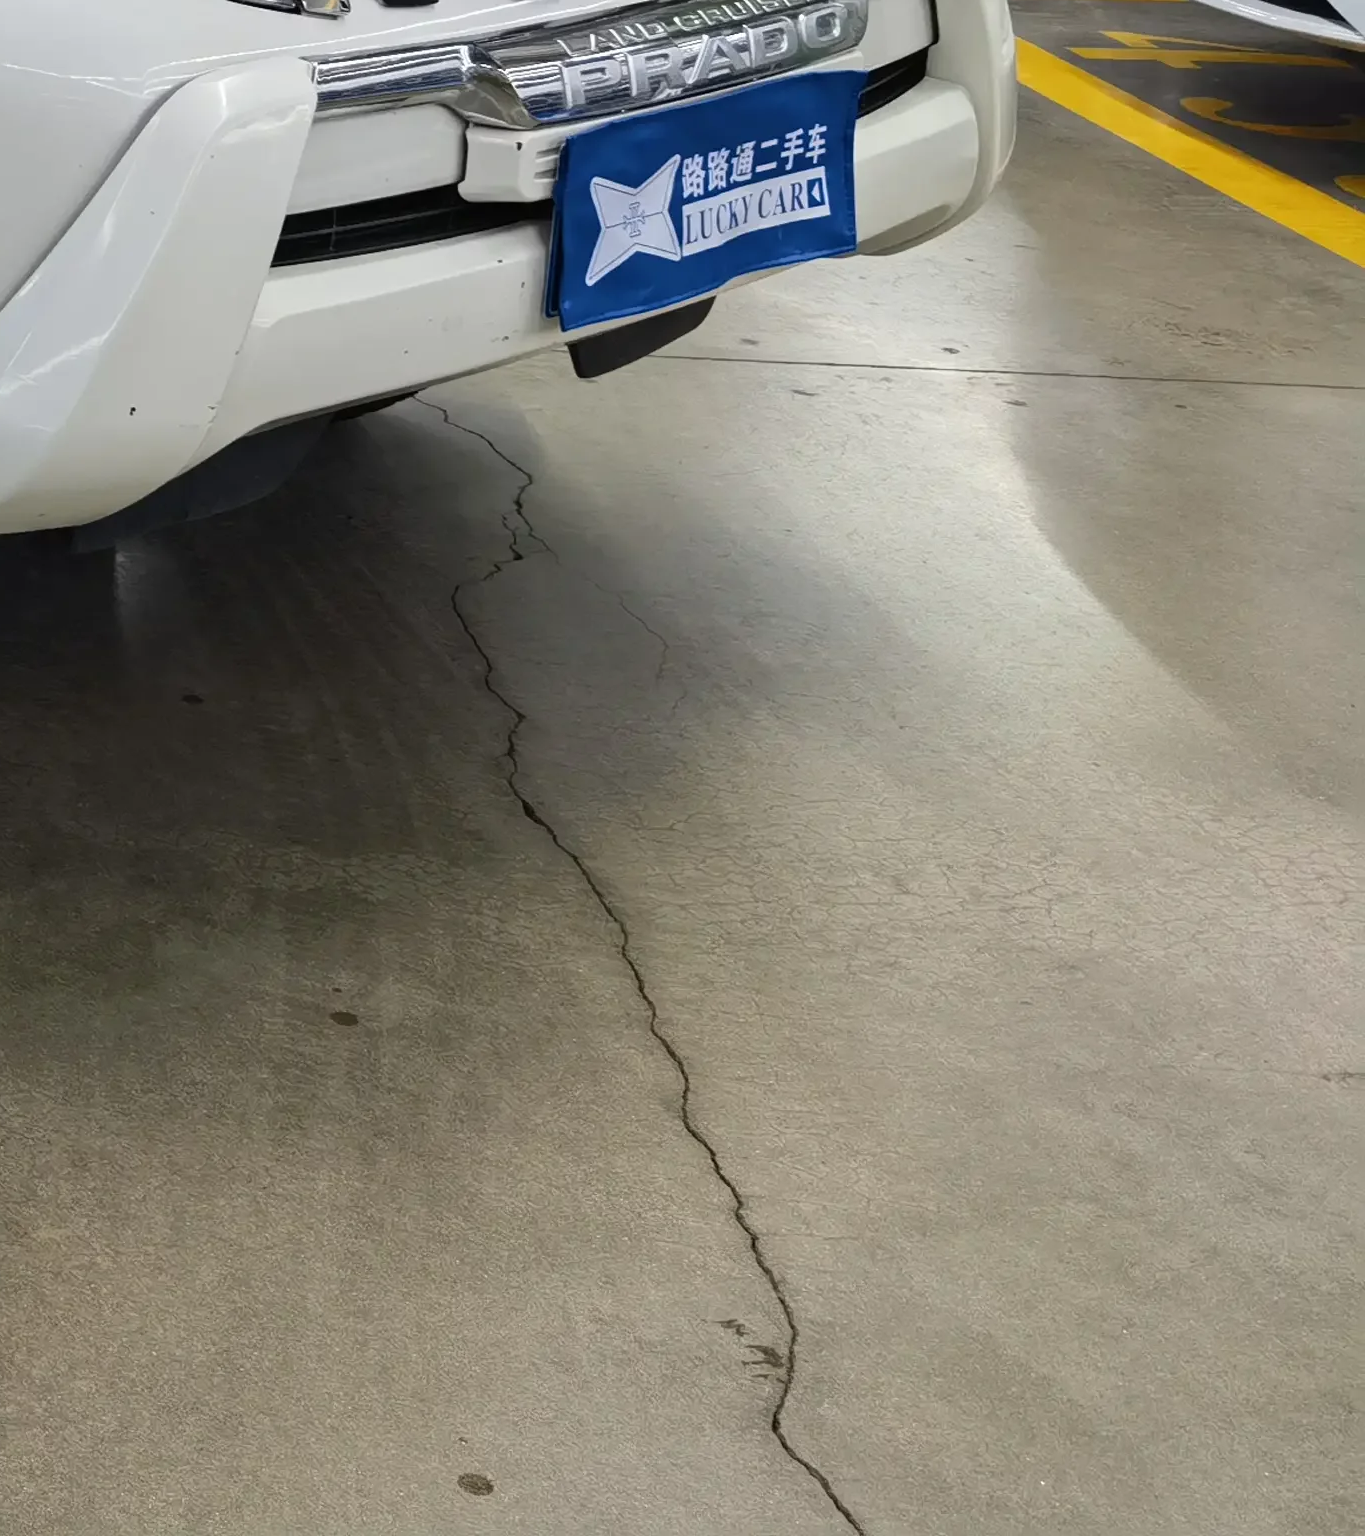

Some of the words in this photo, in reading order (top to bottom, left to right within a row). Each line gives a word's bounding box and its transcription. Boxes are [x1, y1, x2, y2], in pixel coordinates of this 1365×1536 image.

[557, 19, 665, 57] LAND
[558, 0, 849, 112] PRADO
[681, 123, 827, 199] 路路通二手车
[685, 193, 754, 245] LUCKY
[757, 183, 806, 219] CAR
